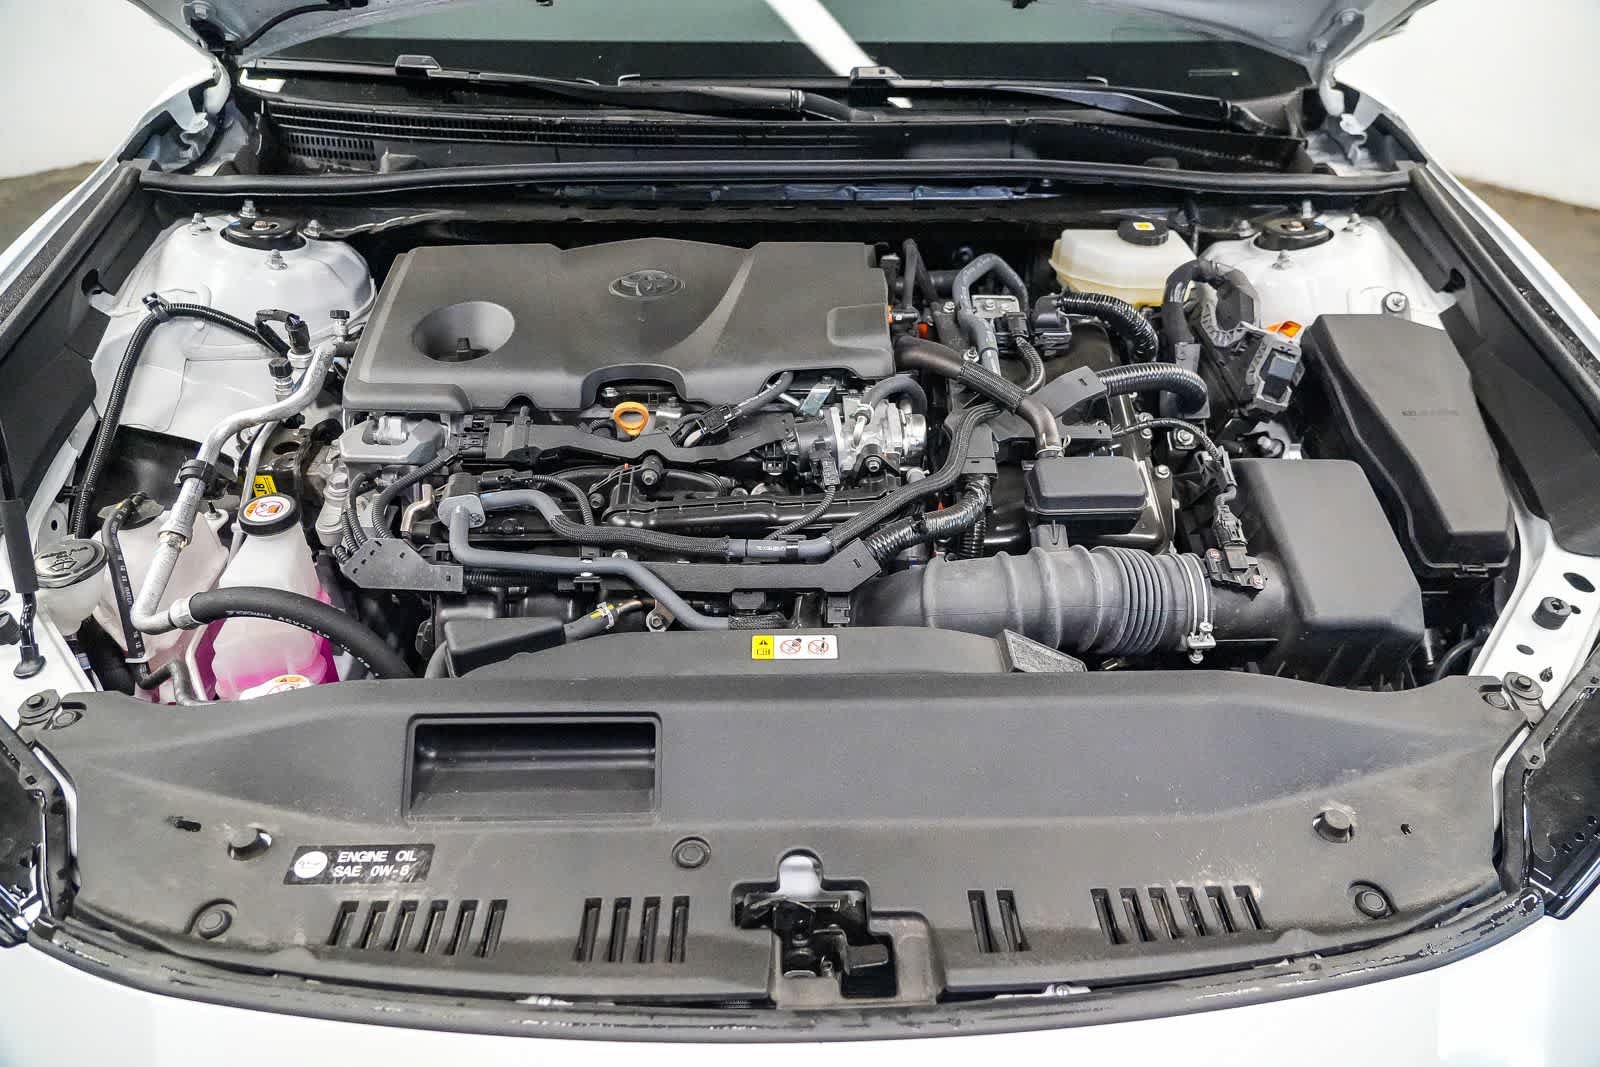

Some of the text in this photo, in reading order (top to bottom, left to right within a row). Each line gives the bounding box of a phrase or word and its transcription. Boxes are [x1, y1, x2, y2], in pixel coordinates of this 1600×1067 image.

[337, 850, 417, 862] ENGINE OIL
[332, 865, 362, 877] SAE
